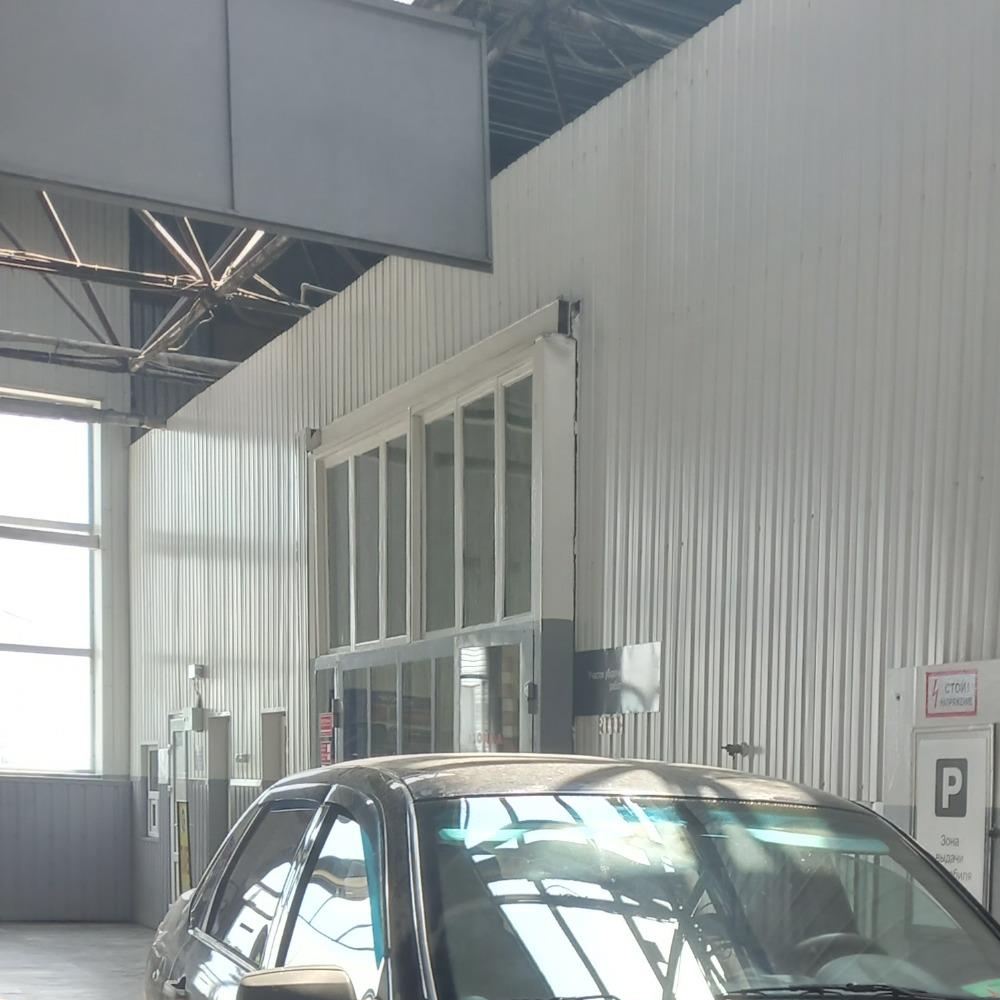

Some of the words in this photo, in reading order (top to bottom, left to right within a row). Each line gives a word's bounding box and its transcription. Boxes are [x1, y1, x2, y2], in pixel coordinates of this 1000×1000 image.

[942, 766, 963, 809] P
[940, 834, 960, 847] Зона
[935, 853, 964, 864] выдачи
